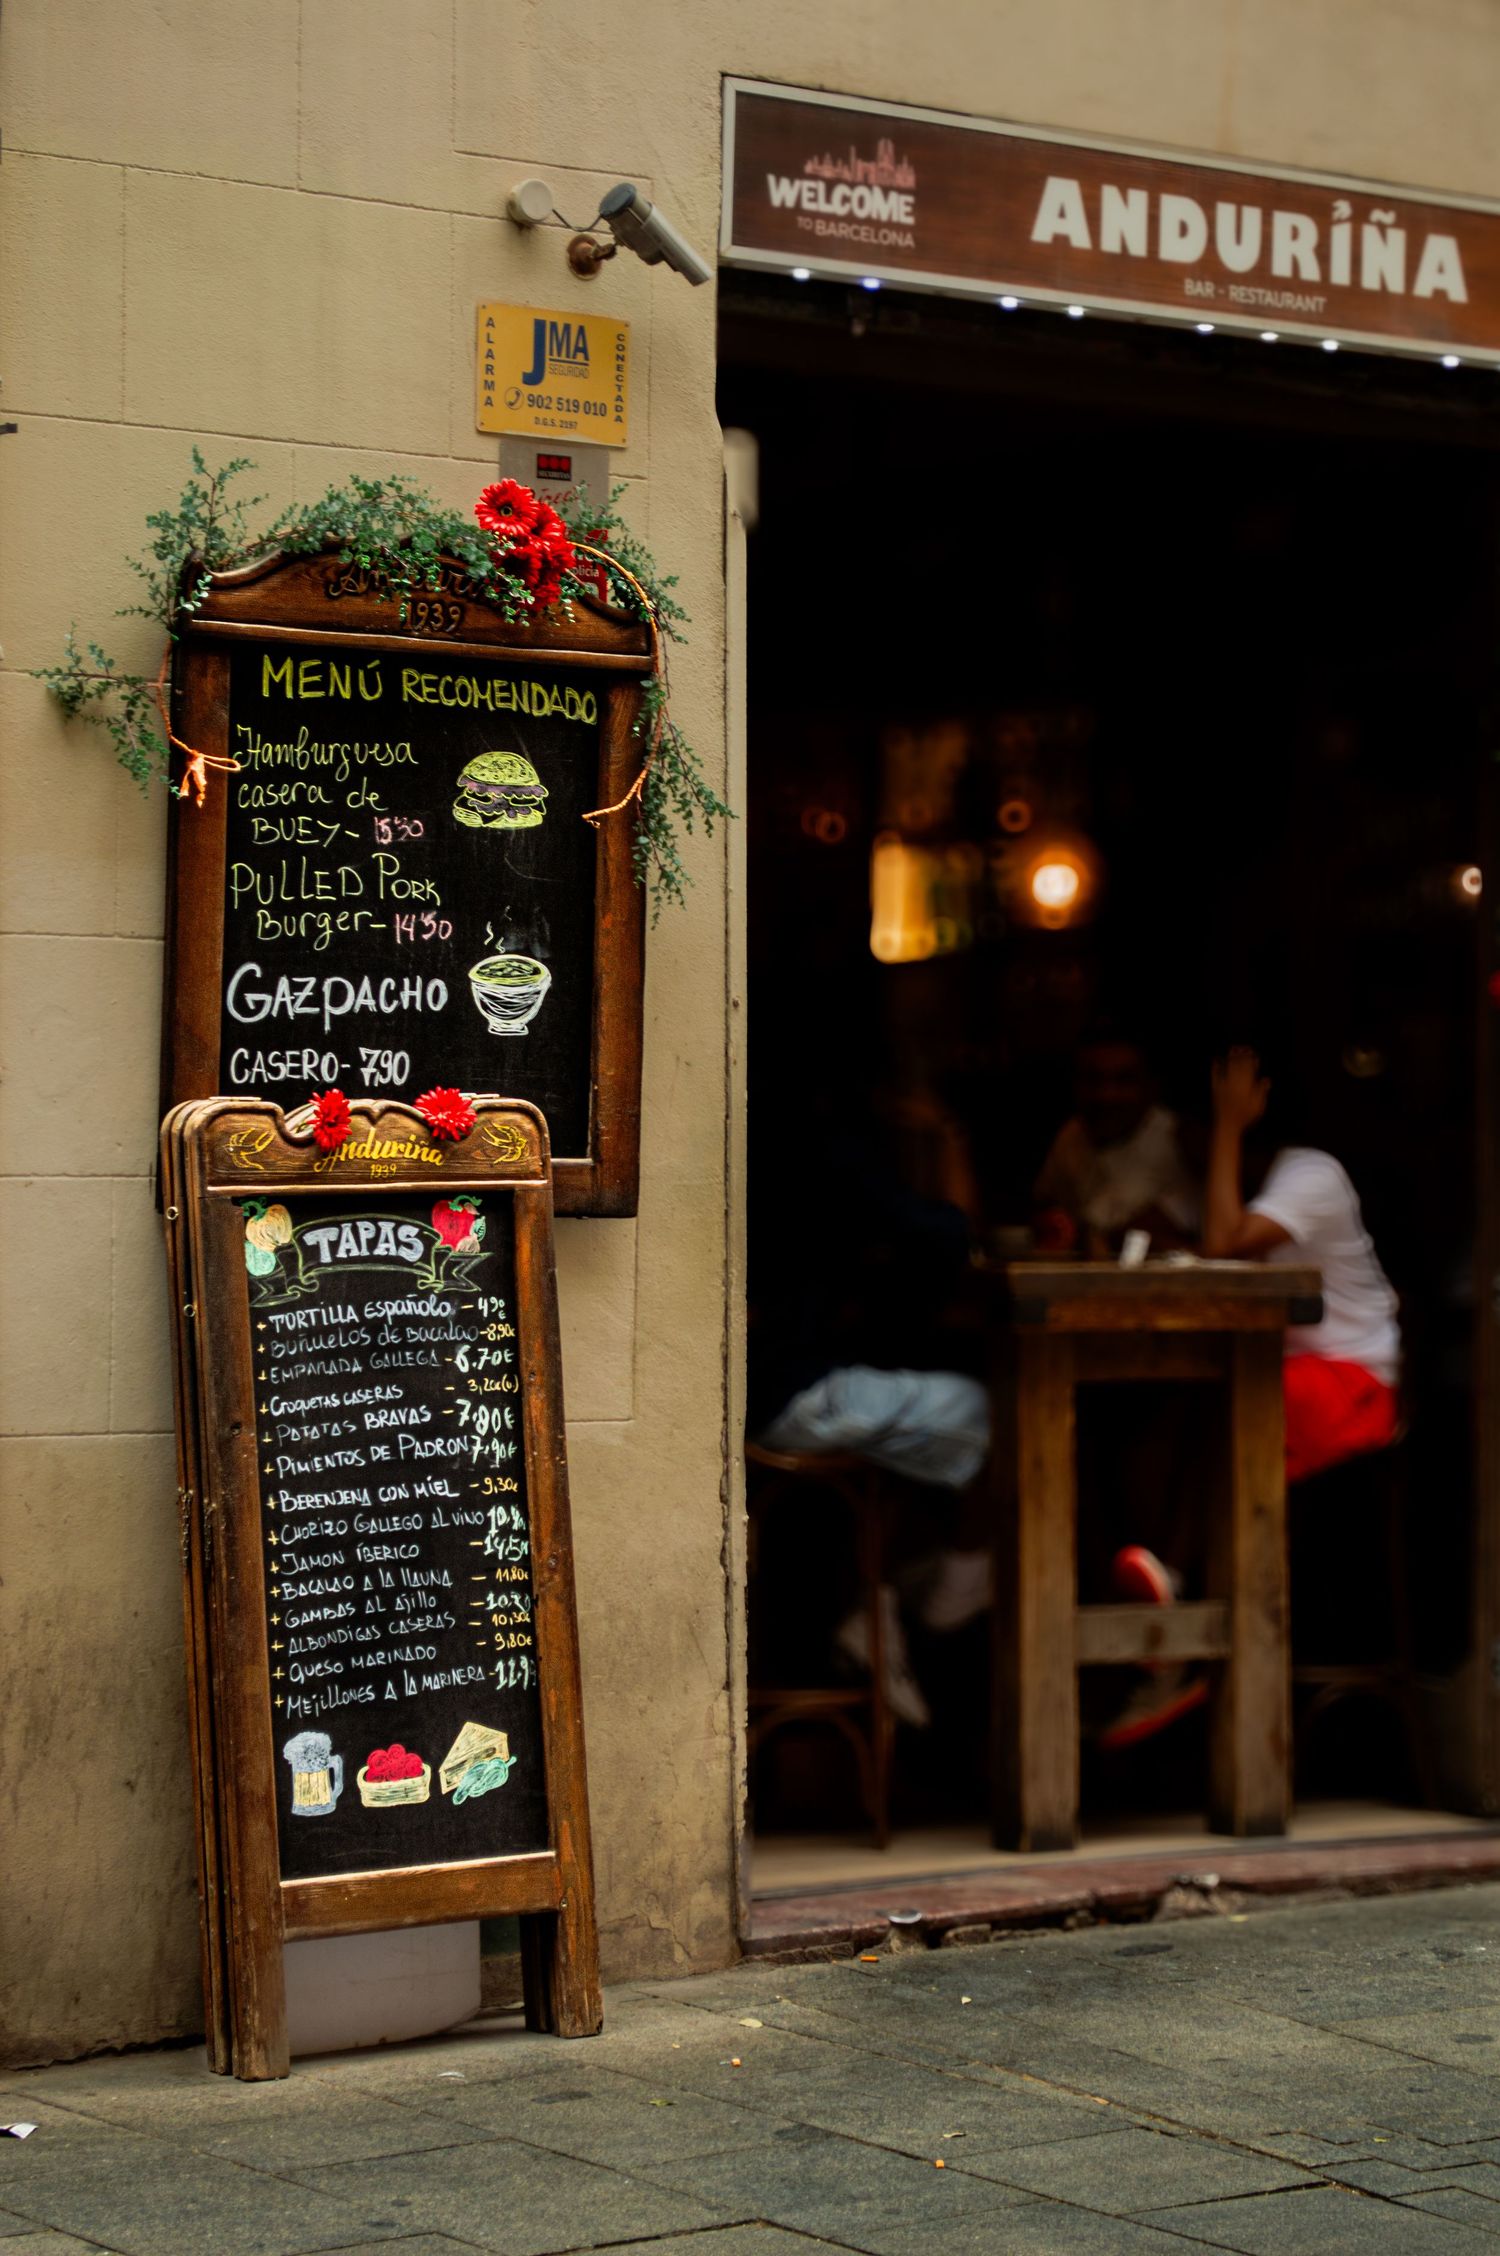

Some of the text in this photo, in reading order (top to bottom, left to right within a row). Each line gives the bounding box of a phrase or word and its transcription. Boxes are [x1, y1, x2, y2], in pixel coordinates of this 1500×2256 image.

[767, 173, 915, 225] WELCOME
[797, 216, 915, 247] TO BARCELONA
[1184, 278, 1215, 298] BAR
[1228, 284, 1327, 313] RESTAURANT
[484, 317, 496, 407] ALARMA
[522, 318, 590, 386] JMA
[548, 363, 590, 379] SEGURIDAD
[613, 333, 626, 423] CONECTADA
[527, 393, 607, 416] 902 519 010
[262, 654, 598, 724] MENÚ RECOMENDADO
[233, 724, 418, 782] Hamburguesa
[238, 776, 389, 811] casera de
[230, 856, 364, 909] PULLED
[226, 962, 449, 1034] GAZPACHO
[314, 1127, 445, 1172] Anduriña
[370, 1163, 397, 1179] 1939
[303, 1220, 424, 1263] TAPAS
[370, 1348, 442, 1369] GALLEGA
[343, 1385, 404, 1405] CASERAS
[276, 1420, 357, 1448] PATATAS
[364, 1405, 432, 1430] BRAVAS
[370, 1445, 392, 1461] DE
[398, 1433, 469, 1460] PADRON
[279, 1488, 372, 1512] BERENJENA
[378, 1483, 409, 1502] CON
[354, 1513, 423, 1534] GALLEGO
[431, 1507, 450, 1529] AL
[281, 1550, 345, 1576] JAMON
[281, 1576, 354, 1600] BACALAO
[363, 1576, 374, 1591] A
[285, 1602, 356, 1629] GAMBAS
[365, 1595, 386, 1613] AL
[388, 1611, 456, 1632] CASERAS
[352, 1646, 437, 1669] MARINADO
[384, 1680, 398, 1701] A
[422, 1665, 486, 1691] MARINERA
